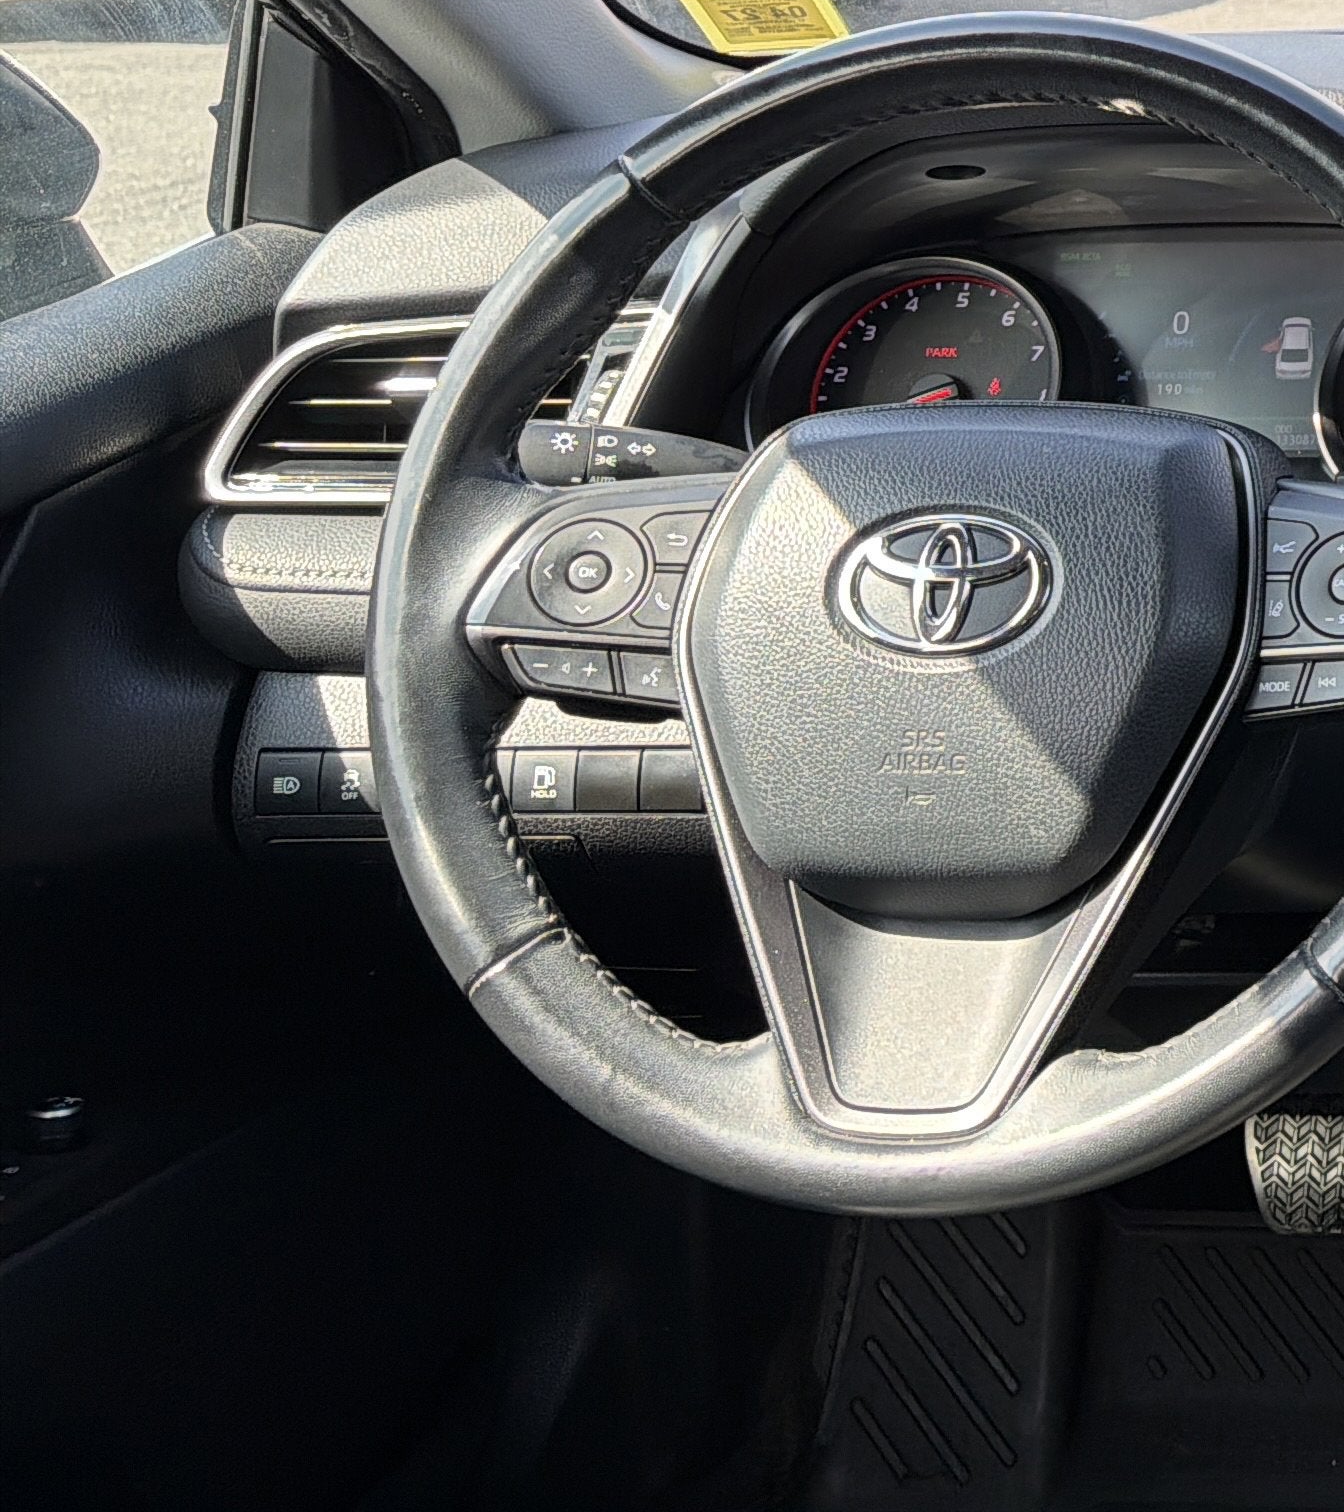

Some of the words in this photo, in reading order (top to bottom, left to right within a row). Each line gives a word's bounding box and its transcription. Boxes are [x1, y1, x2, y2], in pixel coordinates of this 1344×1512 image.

[904, 296, 919, 313] 4
[955, 292, 971, 308] 5
[1001, 310, 1017, 327] 6
[1172, 311, 1190, 335] 0
[862, 325, 878, 342] 3
[925, 347, 958, 358] PARK
[1030, 345, 1045, 361] 7
[833, 366, 849, 383] 2
[1157, 383, 1183, 395] 190
[578, 566, 599, 579] OK
[1259, 681, 1291, 692] MODE
[900, 729, 945, 750] SRS
[880, 752, 967, 774] AIRBAG
[341, 791, 359, 801] OFF
[531, 790, 557, 799] HOLD
